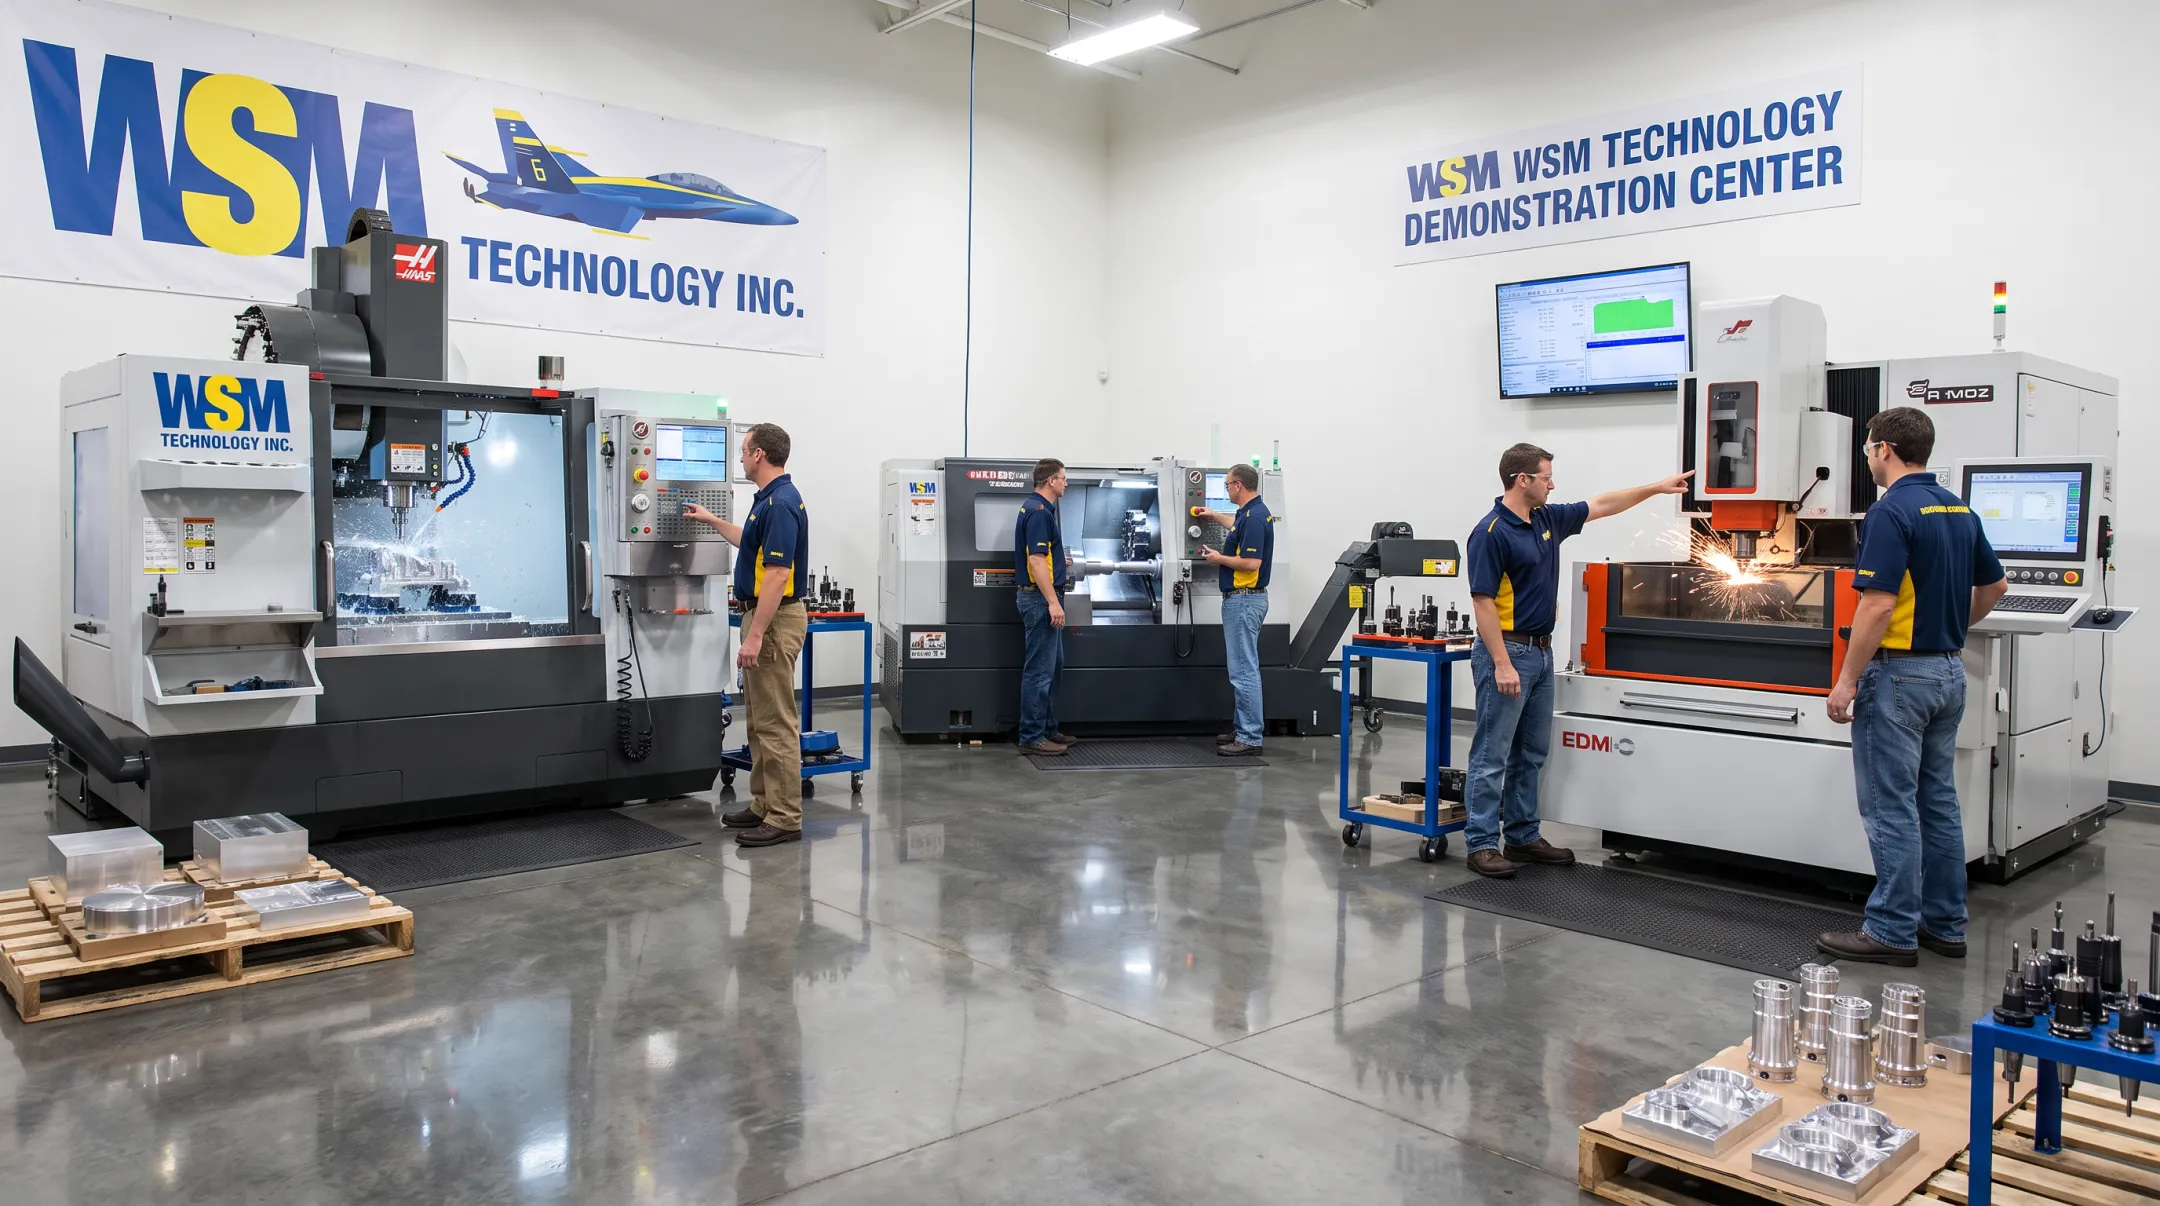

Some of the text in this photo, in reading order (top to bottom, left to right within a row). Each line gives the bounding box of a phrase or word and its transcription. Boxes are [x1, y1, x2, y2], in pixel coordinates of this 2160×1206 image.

[22, 38, 428, 258] WSM
[530, 158, 547, 182] 6
[1407, 90, 1843, 203] WSM WSM TECHNOLOGY
[1404, 145, 1844, 247] DEMONSTRATION CENTER
[396, 269, 436, 281] HAAS
[461, 236, 804, 318] TECHNOLOGY INC.
[153, 372, 290, 433] WSM
[160, 433, 293, 452] TECHNOLOGY INC.
[1562, 730, 1610, 752] EDM
